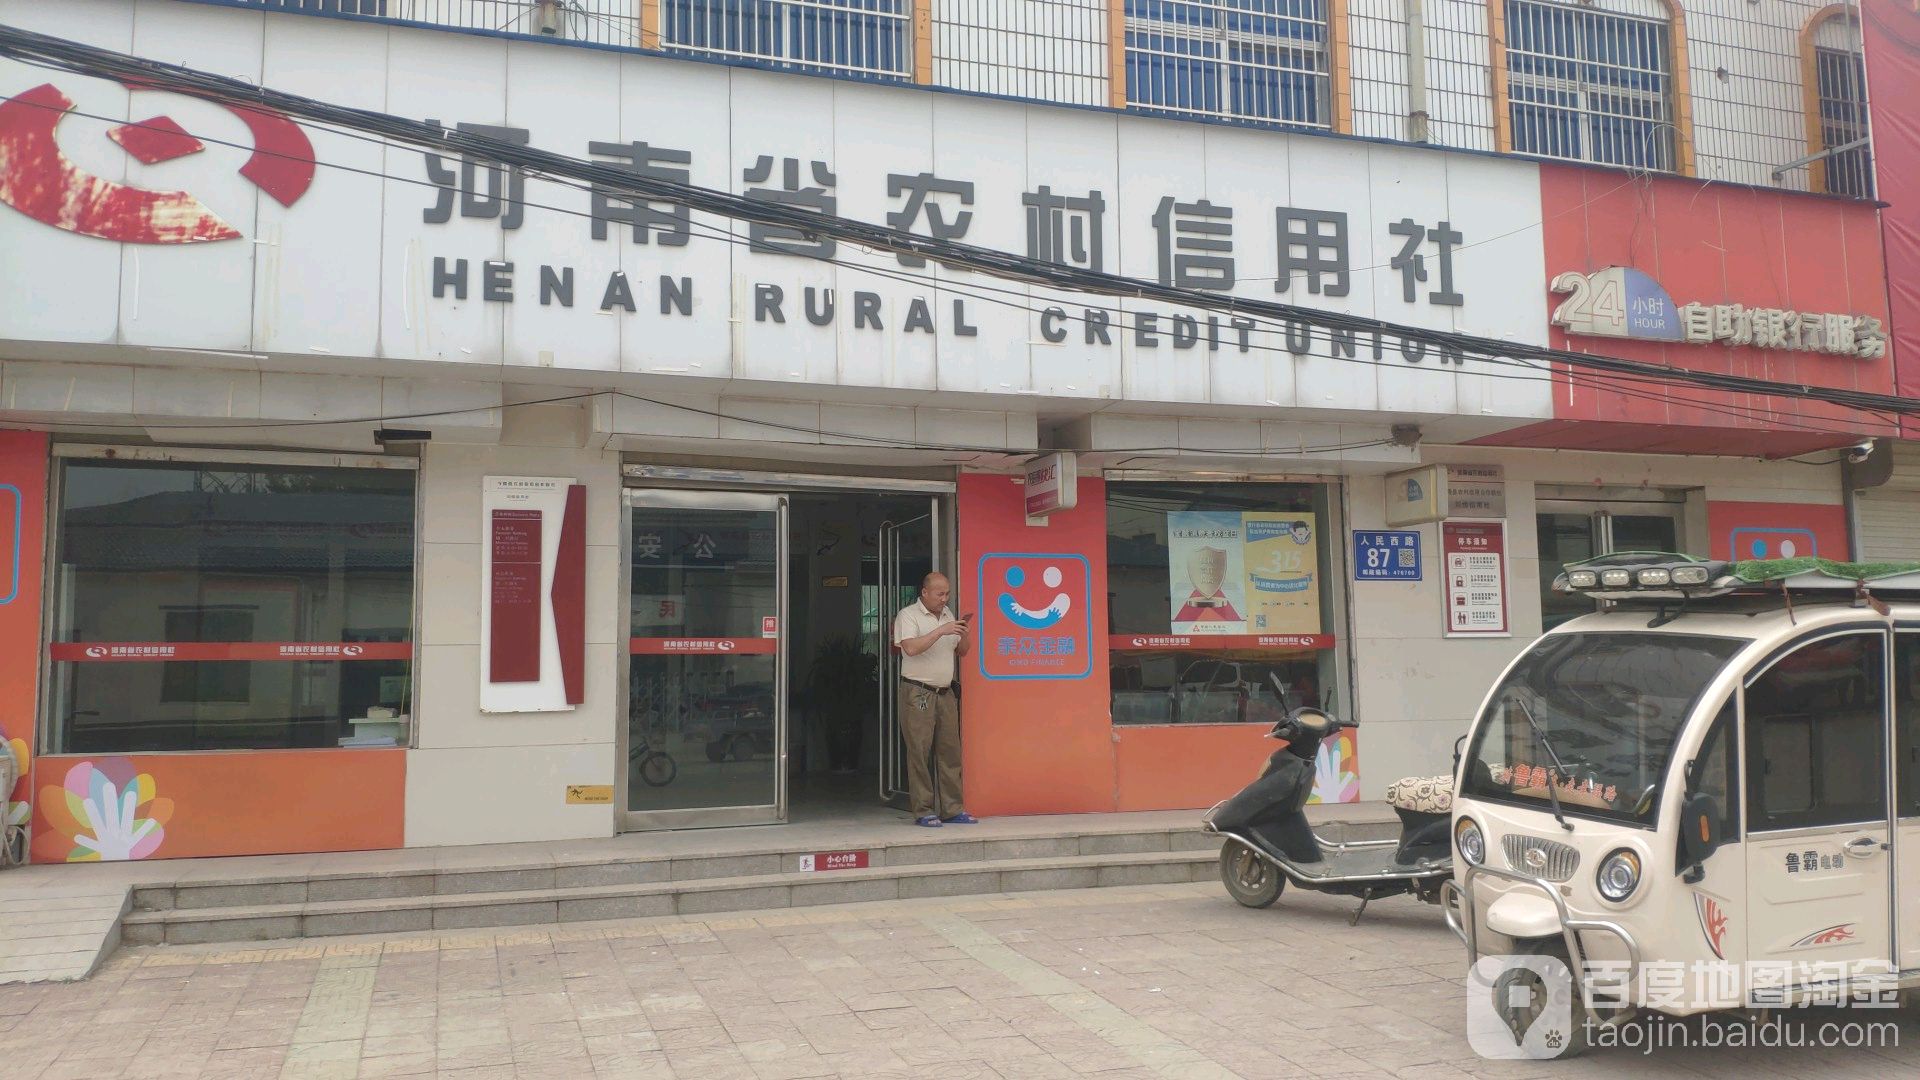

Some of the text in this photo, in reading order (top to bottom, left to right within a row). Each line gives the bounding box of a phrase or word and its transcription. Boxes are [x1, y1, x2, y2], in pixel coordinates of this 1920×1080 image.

[423, 119, 1464, 306] 河南省农村信用社
[432, 256, 692, 316] HENAN
[755, 284, 978, 337] RURAL
[1040, 306, 1256, 352] CREDIT
[1550, 271, 1664, 331] 24 小时
[1634, 317, 1665, 330] HOUR
[1683, 301, 1887, 360] 自助银行服务
[1361, 535, 1414, 546] 人民西路
[1367, 547, 1390, 568] 87
